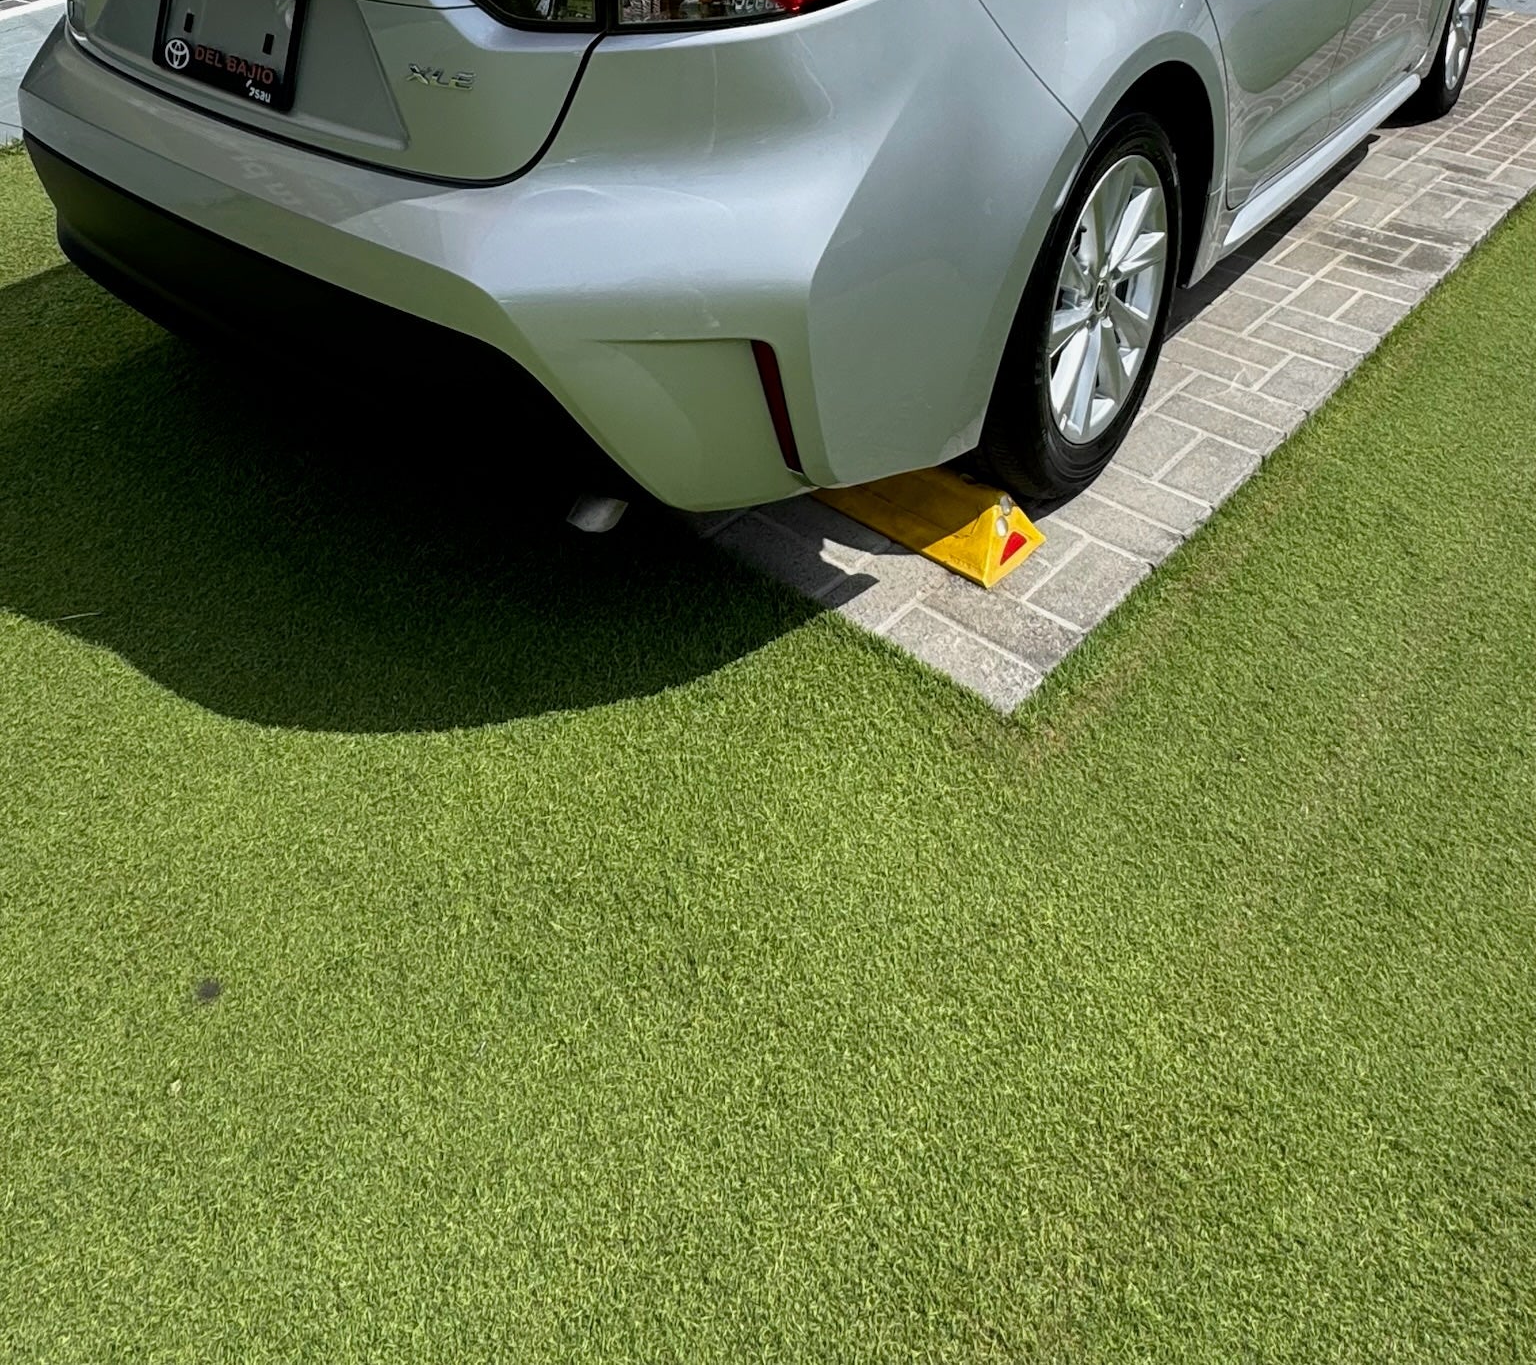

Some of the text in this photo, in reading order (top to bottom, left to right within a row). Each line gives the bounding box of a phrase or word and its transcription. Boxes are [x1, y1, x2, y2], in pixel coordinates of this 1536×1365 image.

[194, 45, 274, 85] DEL BAJIO
[406, 63, 476, 91] XLE
